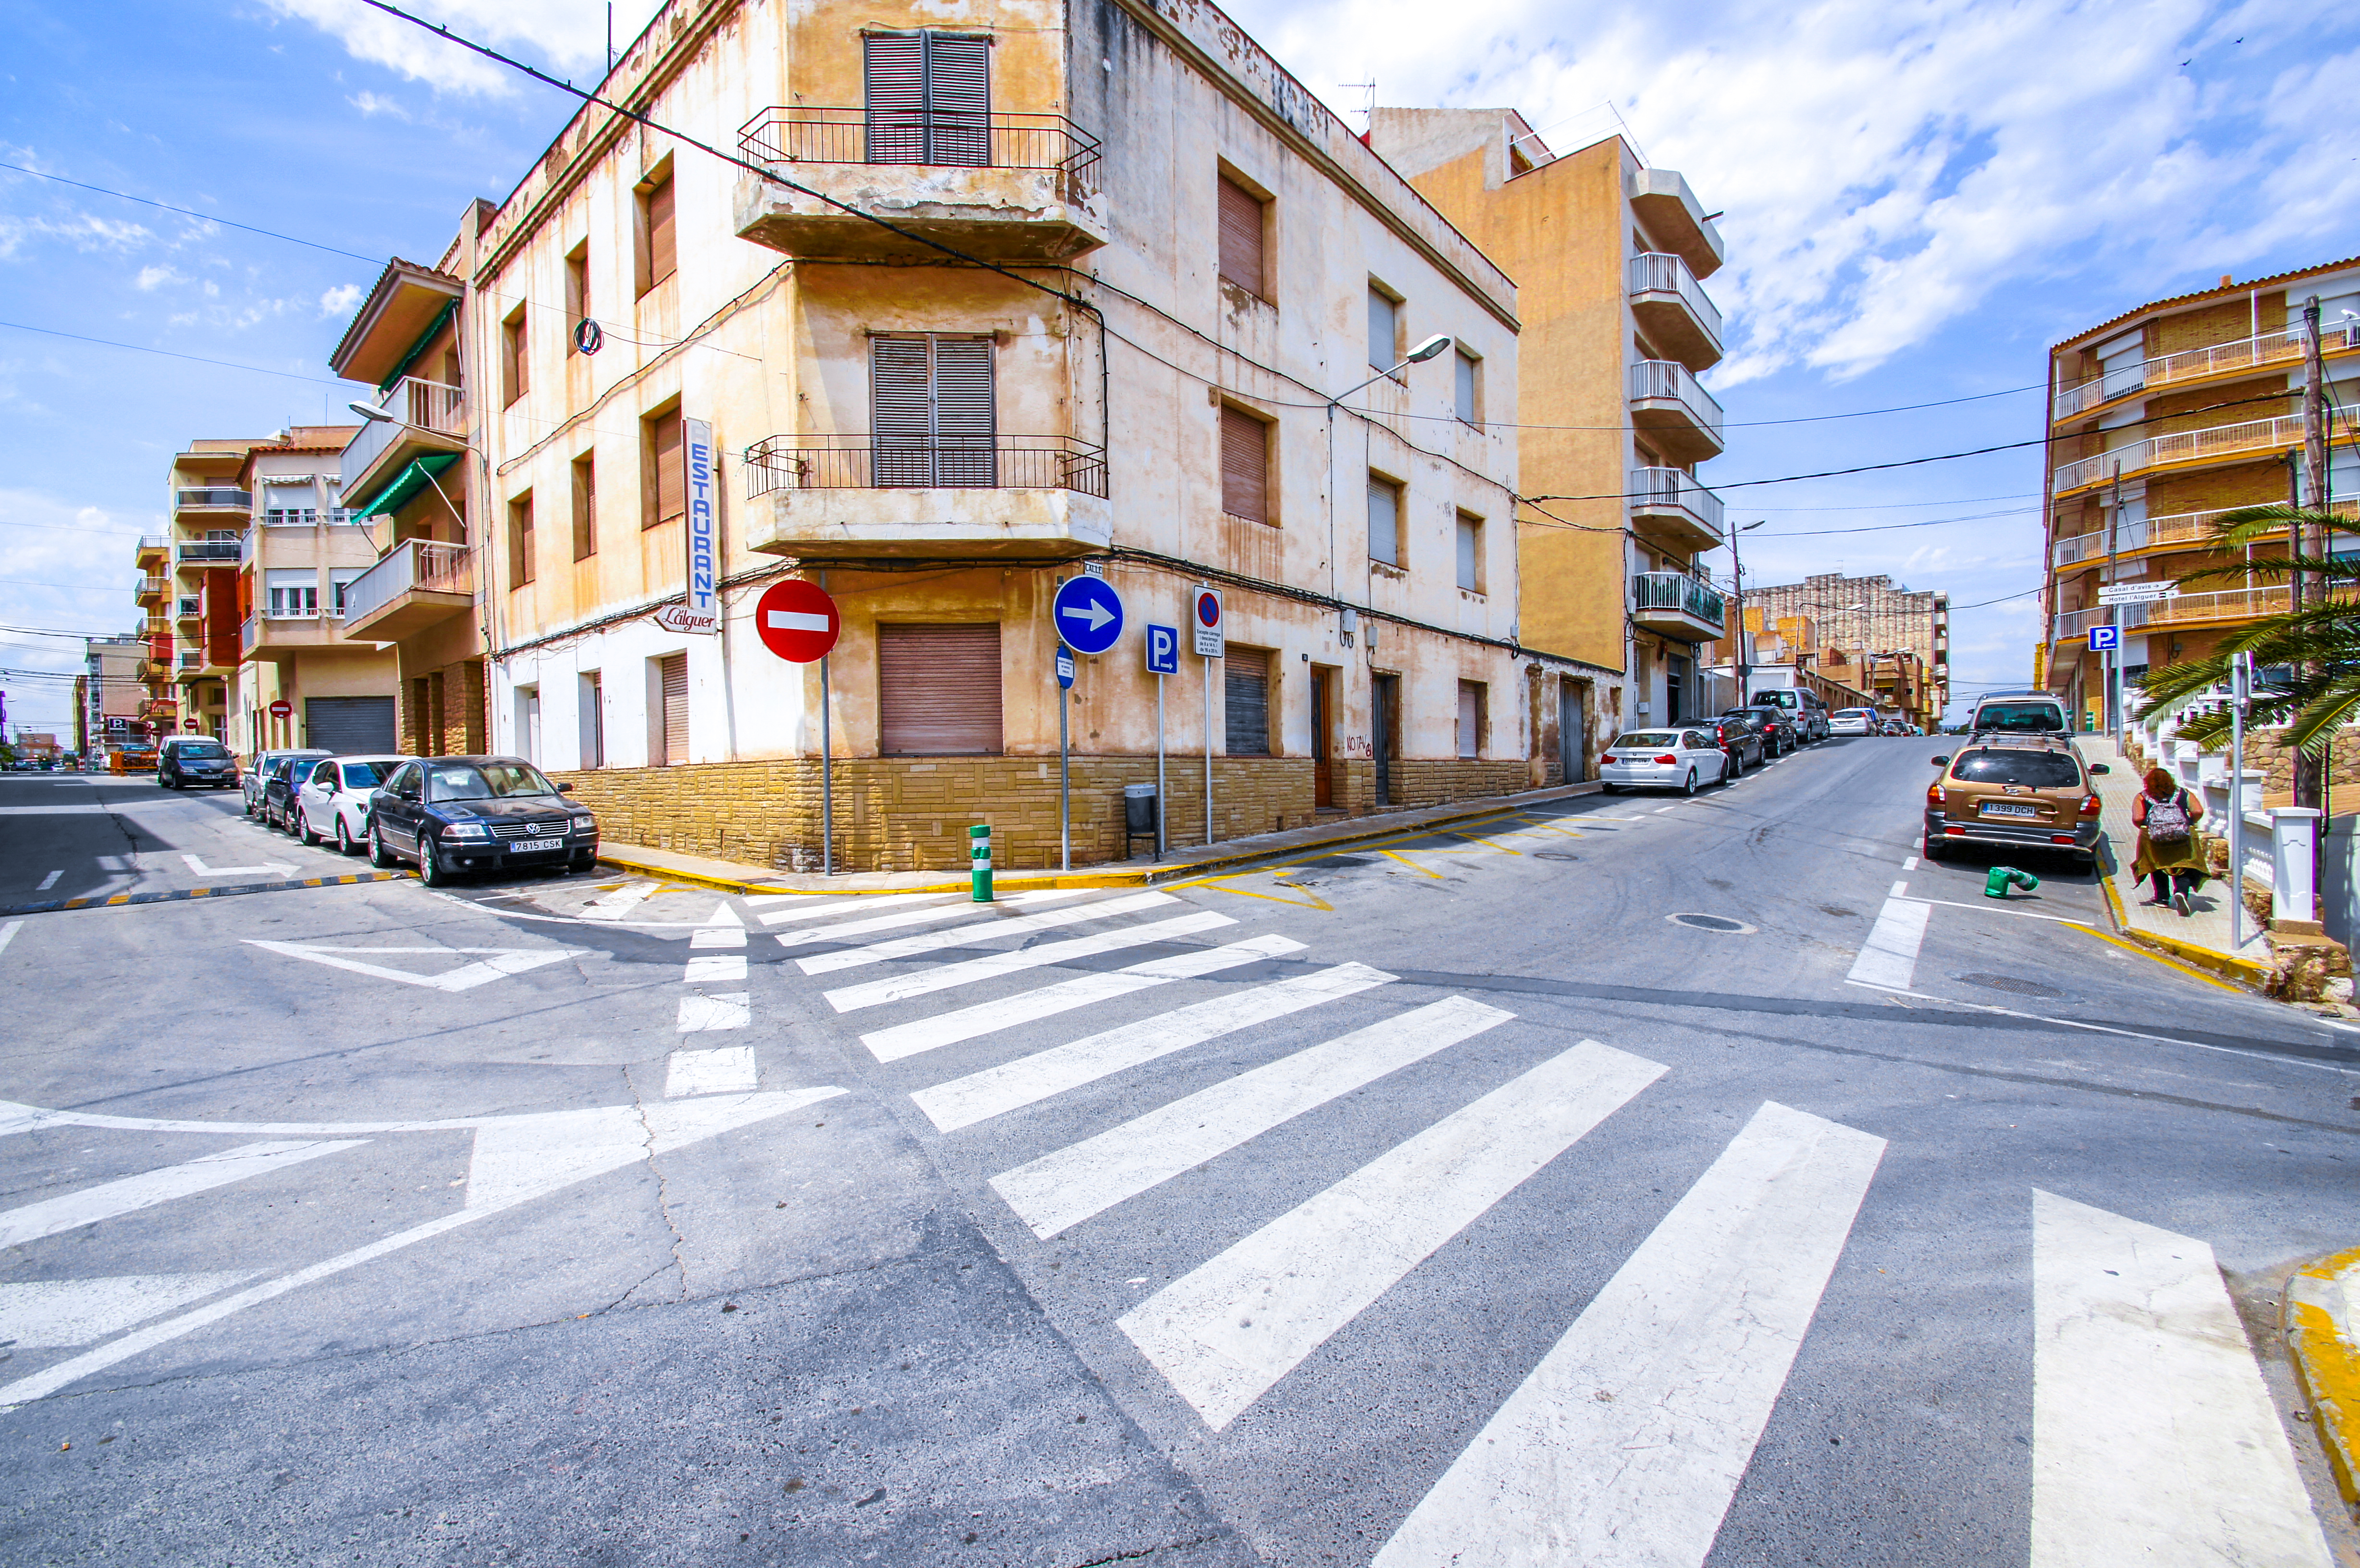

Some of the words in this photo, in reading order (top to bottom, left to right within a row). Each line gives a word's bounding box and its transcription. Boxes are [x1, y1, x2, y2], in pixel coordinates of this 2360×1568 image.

[1085, 564, 1102, 574] CALLE
[2095, 628, 2113, 648] P
[1154, 629, 1171, 667] P
[1347, 735, 1355, 752] NO
[1356, 734, 1366, 751] TAV
[1990, 804, 2012, 812] 1399
[516, 842, 539, 851] 7815
[544, 840, 560, 848] CSK
